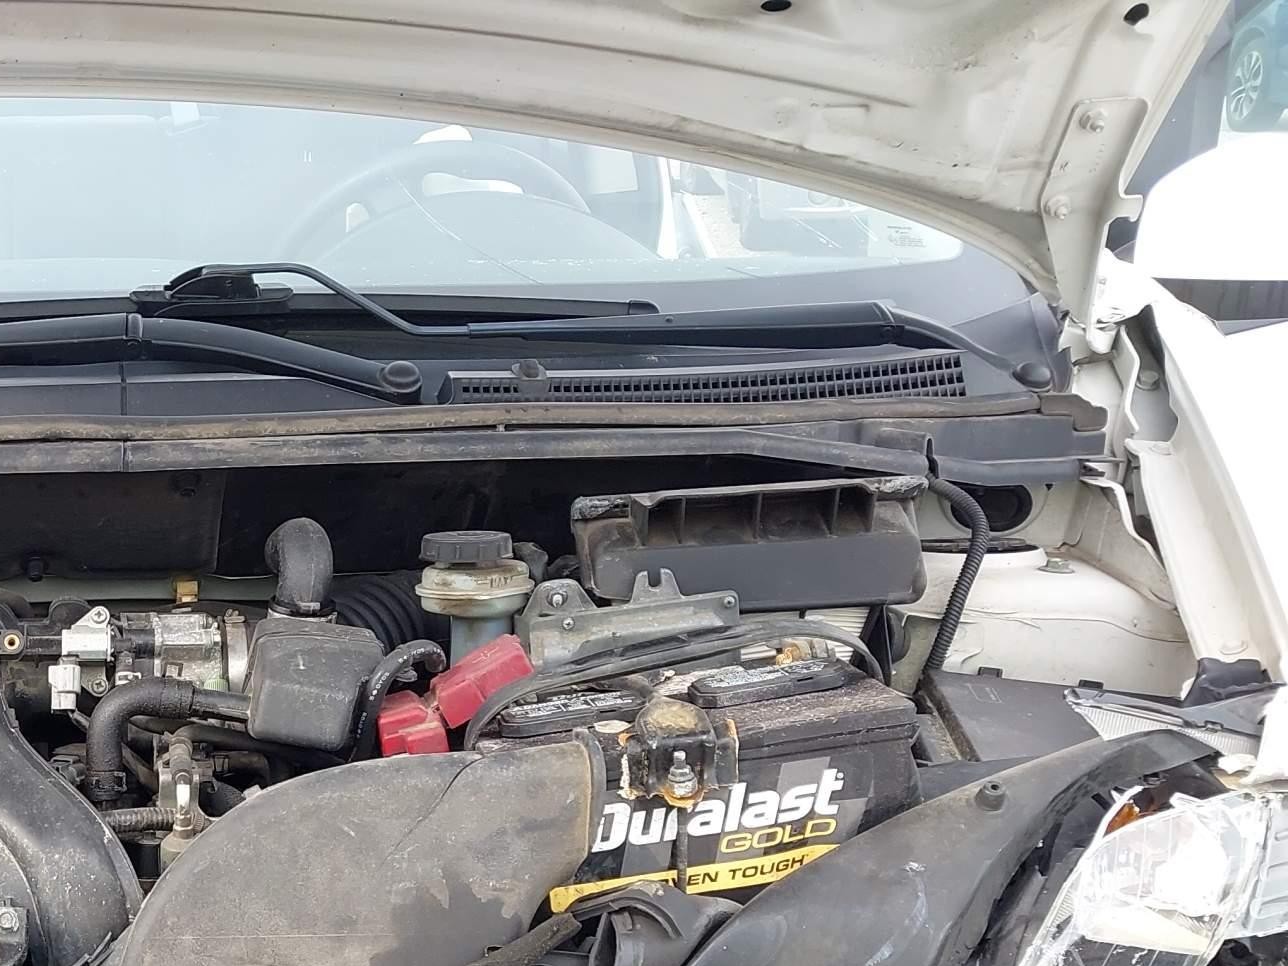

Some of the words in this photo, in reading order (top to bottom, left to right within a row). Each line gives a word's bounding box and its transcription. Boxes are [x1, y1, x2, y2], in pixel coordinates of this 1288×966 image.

[591, 769, 844, 853] Duralast
[720, 818, 837, 854] GOLD
[728, 854, 806, 880] TOUGH
